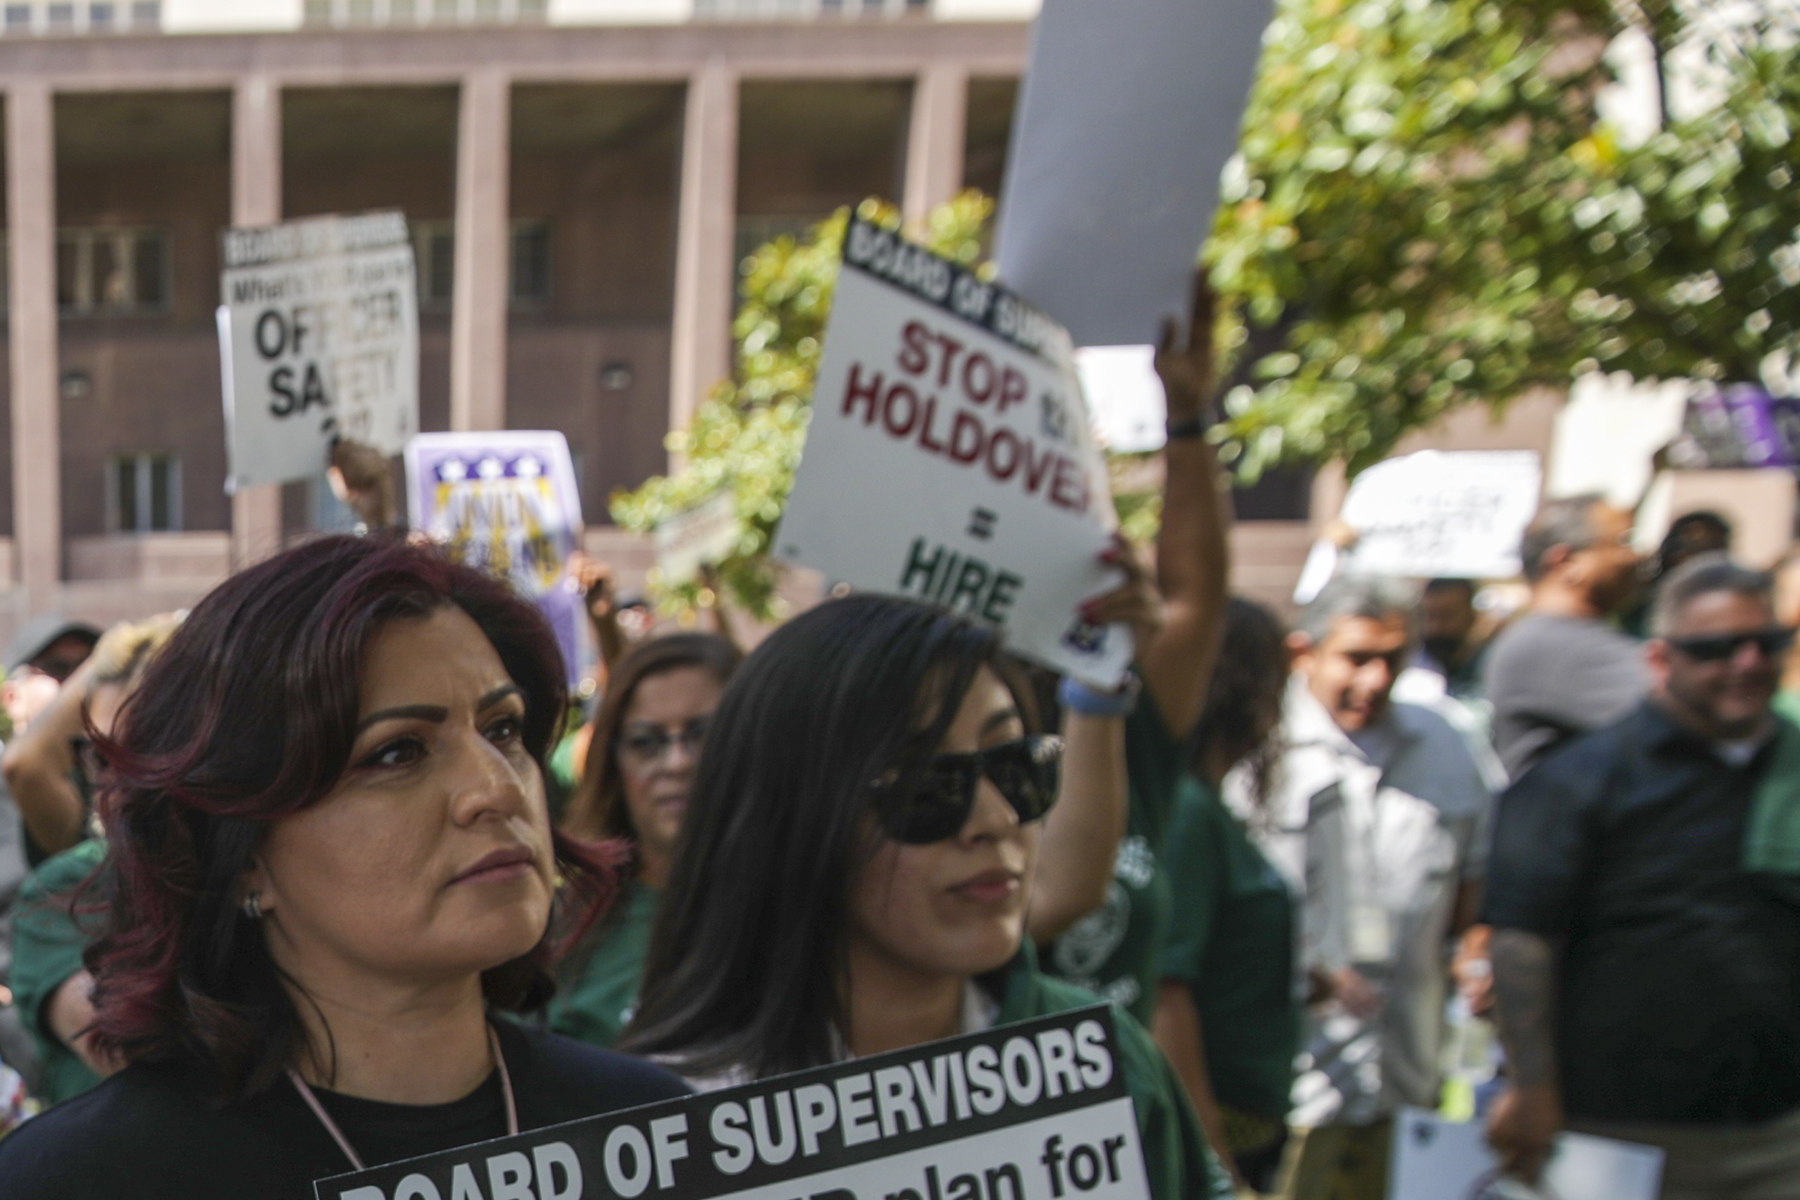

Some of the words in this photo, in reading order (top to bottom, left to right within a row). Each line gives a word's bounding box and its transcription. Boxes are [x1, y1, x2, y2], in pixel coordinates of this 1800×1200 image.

[850, 219, 949, 301] BOARD
[952, 270, 994, 320] OF
[898, 318, 1029, 416] STOP
[900, 535, 1025, 624] HIRE
[604, 1116, 689, 1199] OF
[711, 1020, 1113, 1176] SUPERVISORS
[1040, 1134, 1128, 1200] for
